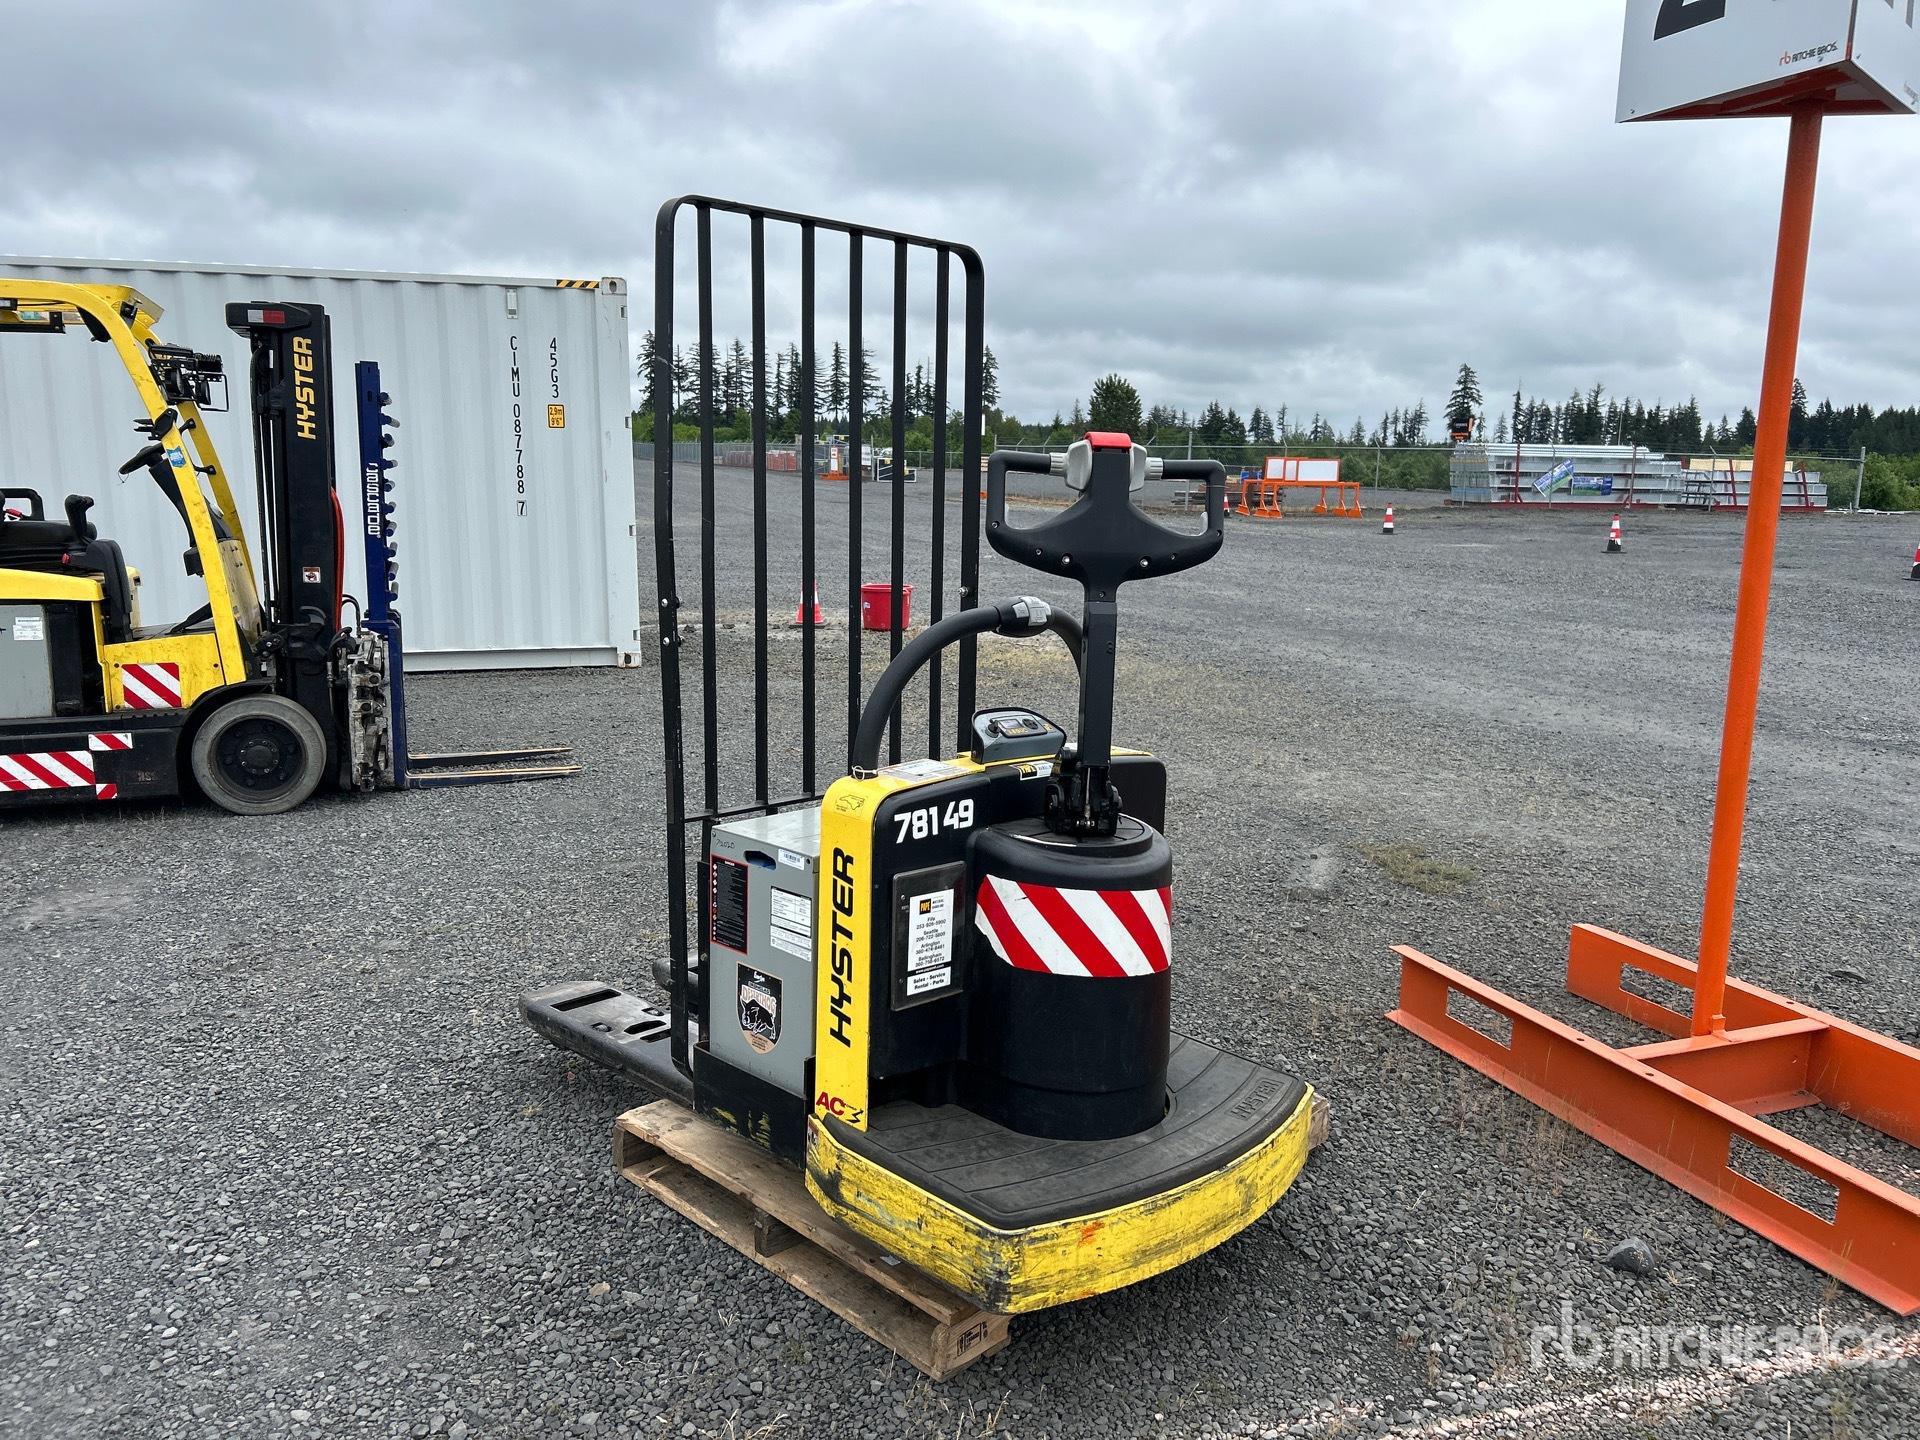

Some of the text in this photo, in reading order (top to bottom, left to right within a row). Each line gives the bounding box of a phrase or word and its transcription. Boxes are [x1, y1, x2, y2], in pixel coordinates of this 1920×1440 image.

[1792, 48, 1816, 63] RITCHIE
[293, 336, 316, 440] HYSTER
[510, 335, 521, 397] CIMU
[549, 337, 560, 398] 45G3
[513, 403, 525, 494] 087788
[829, 847, 854, 1048] HYSTER
[929, 972, 946, 981] Service
[815, 1091, 847, 1116] AC
